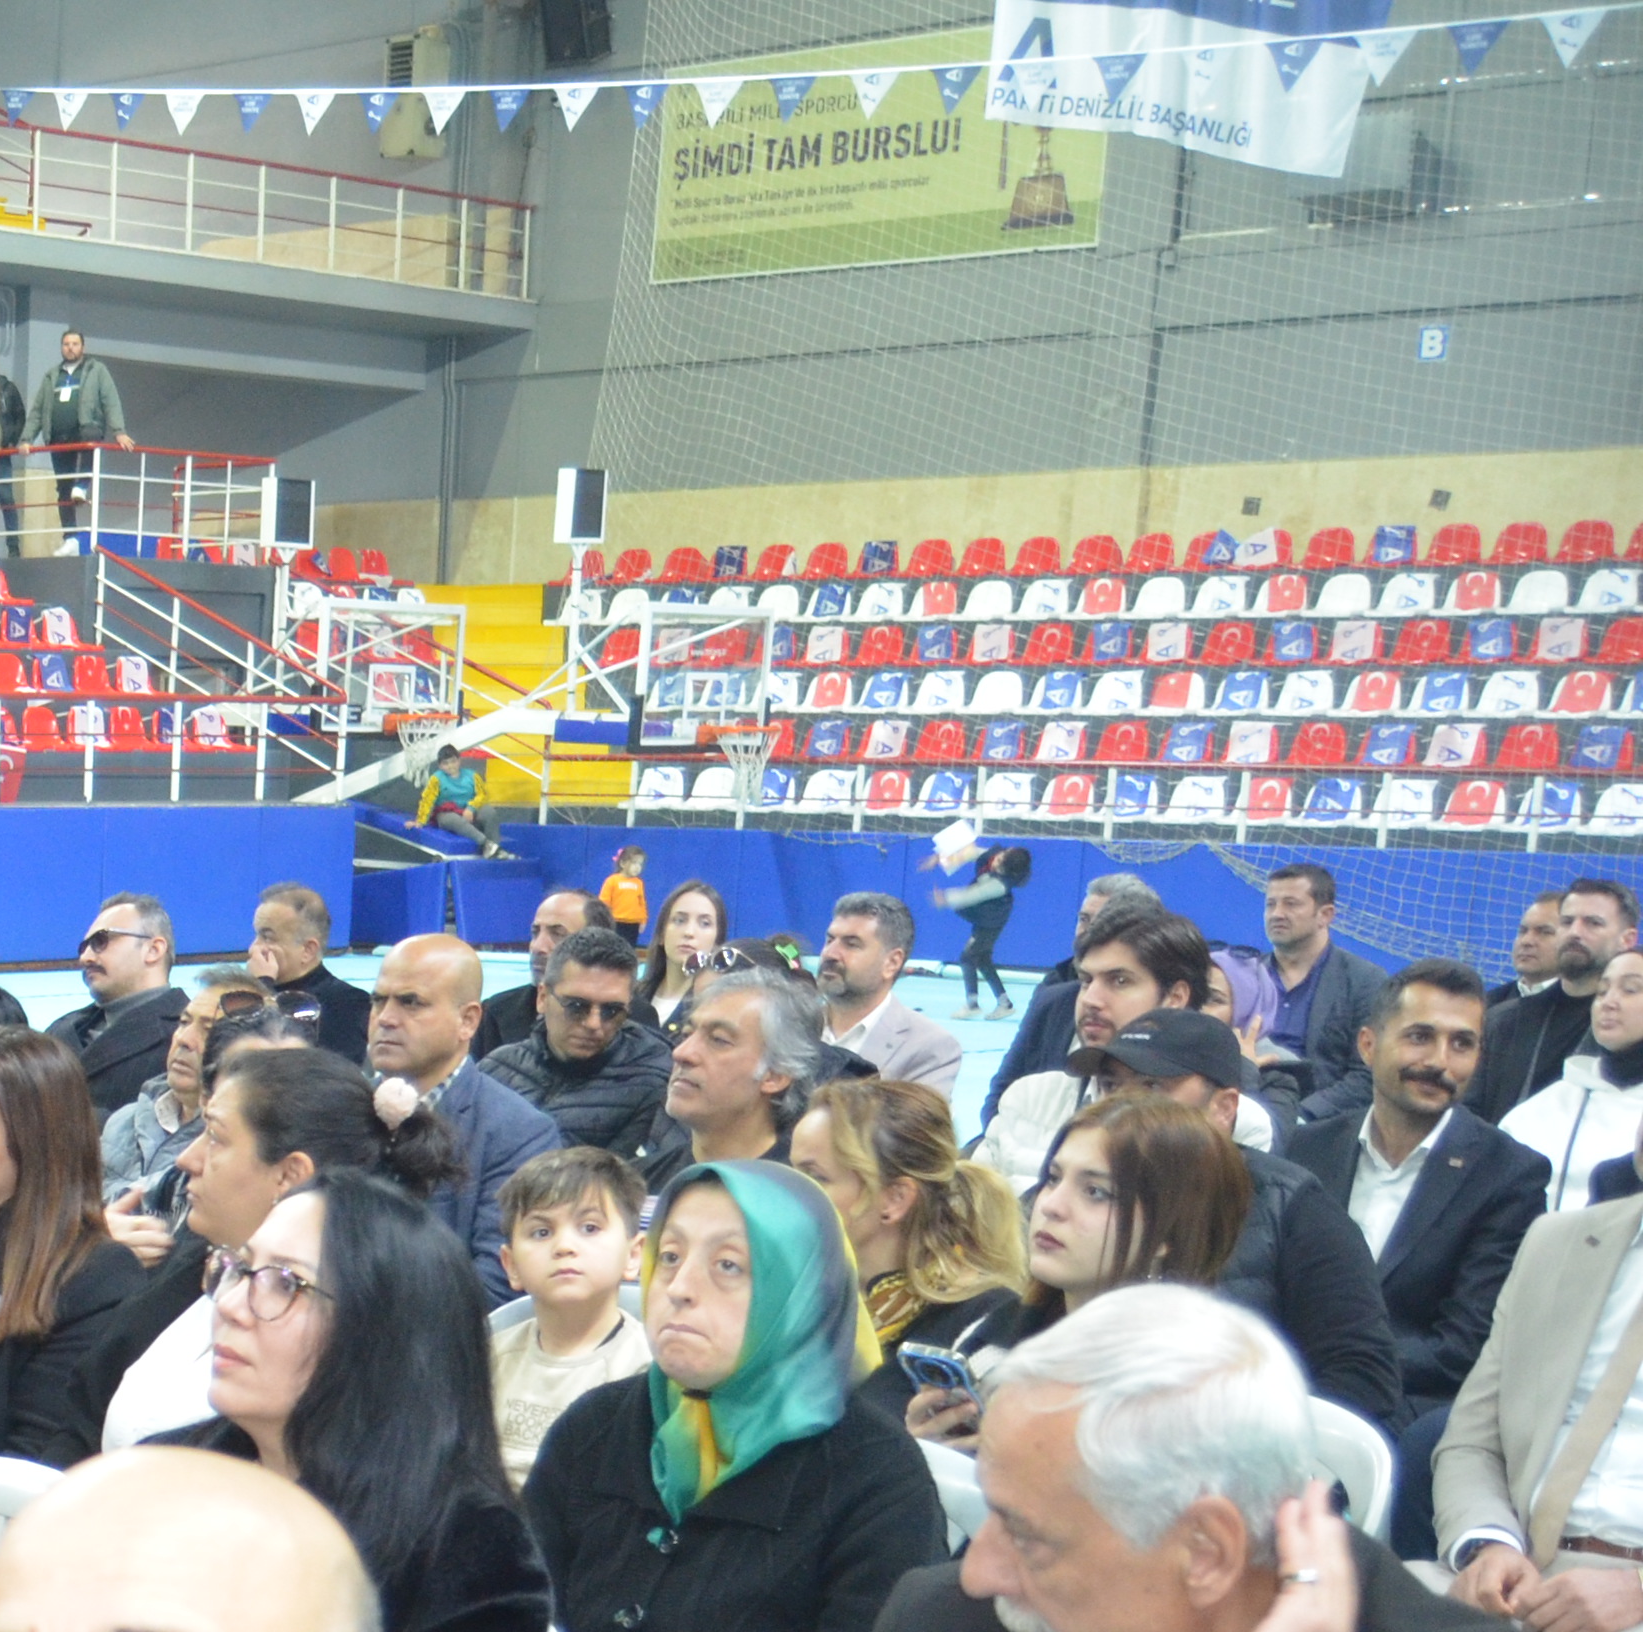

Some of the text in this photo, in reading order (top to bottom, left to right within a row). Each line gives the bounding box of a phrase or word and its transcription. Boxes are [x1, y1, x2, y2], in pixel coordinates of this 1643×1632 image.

[674, 118, 962, 190] ŞİMDİ TAM BURSLU!
[1421, 329, 1444, 358] B
